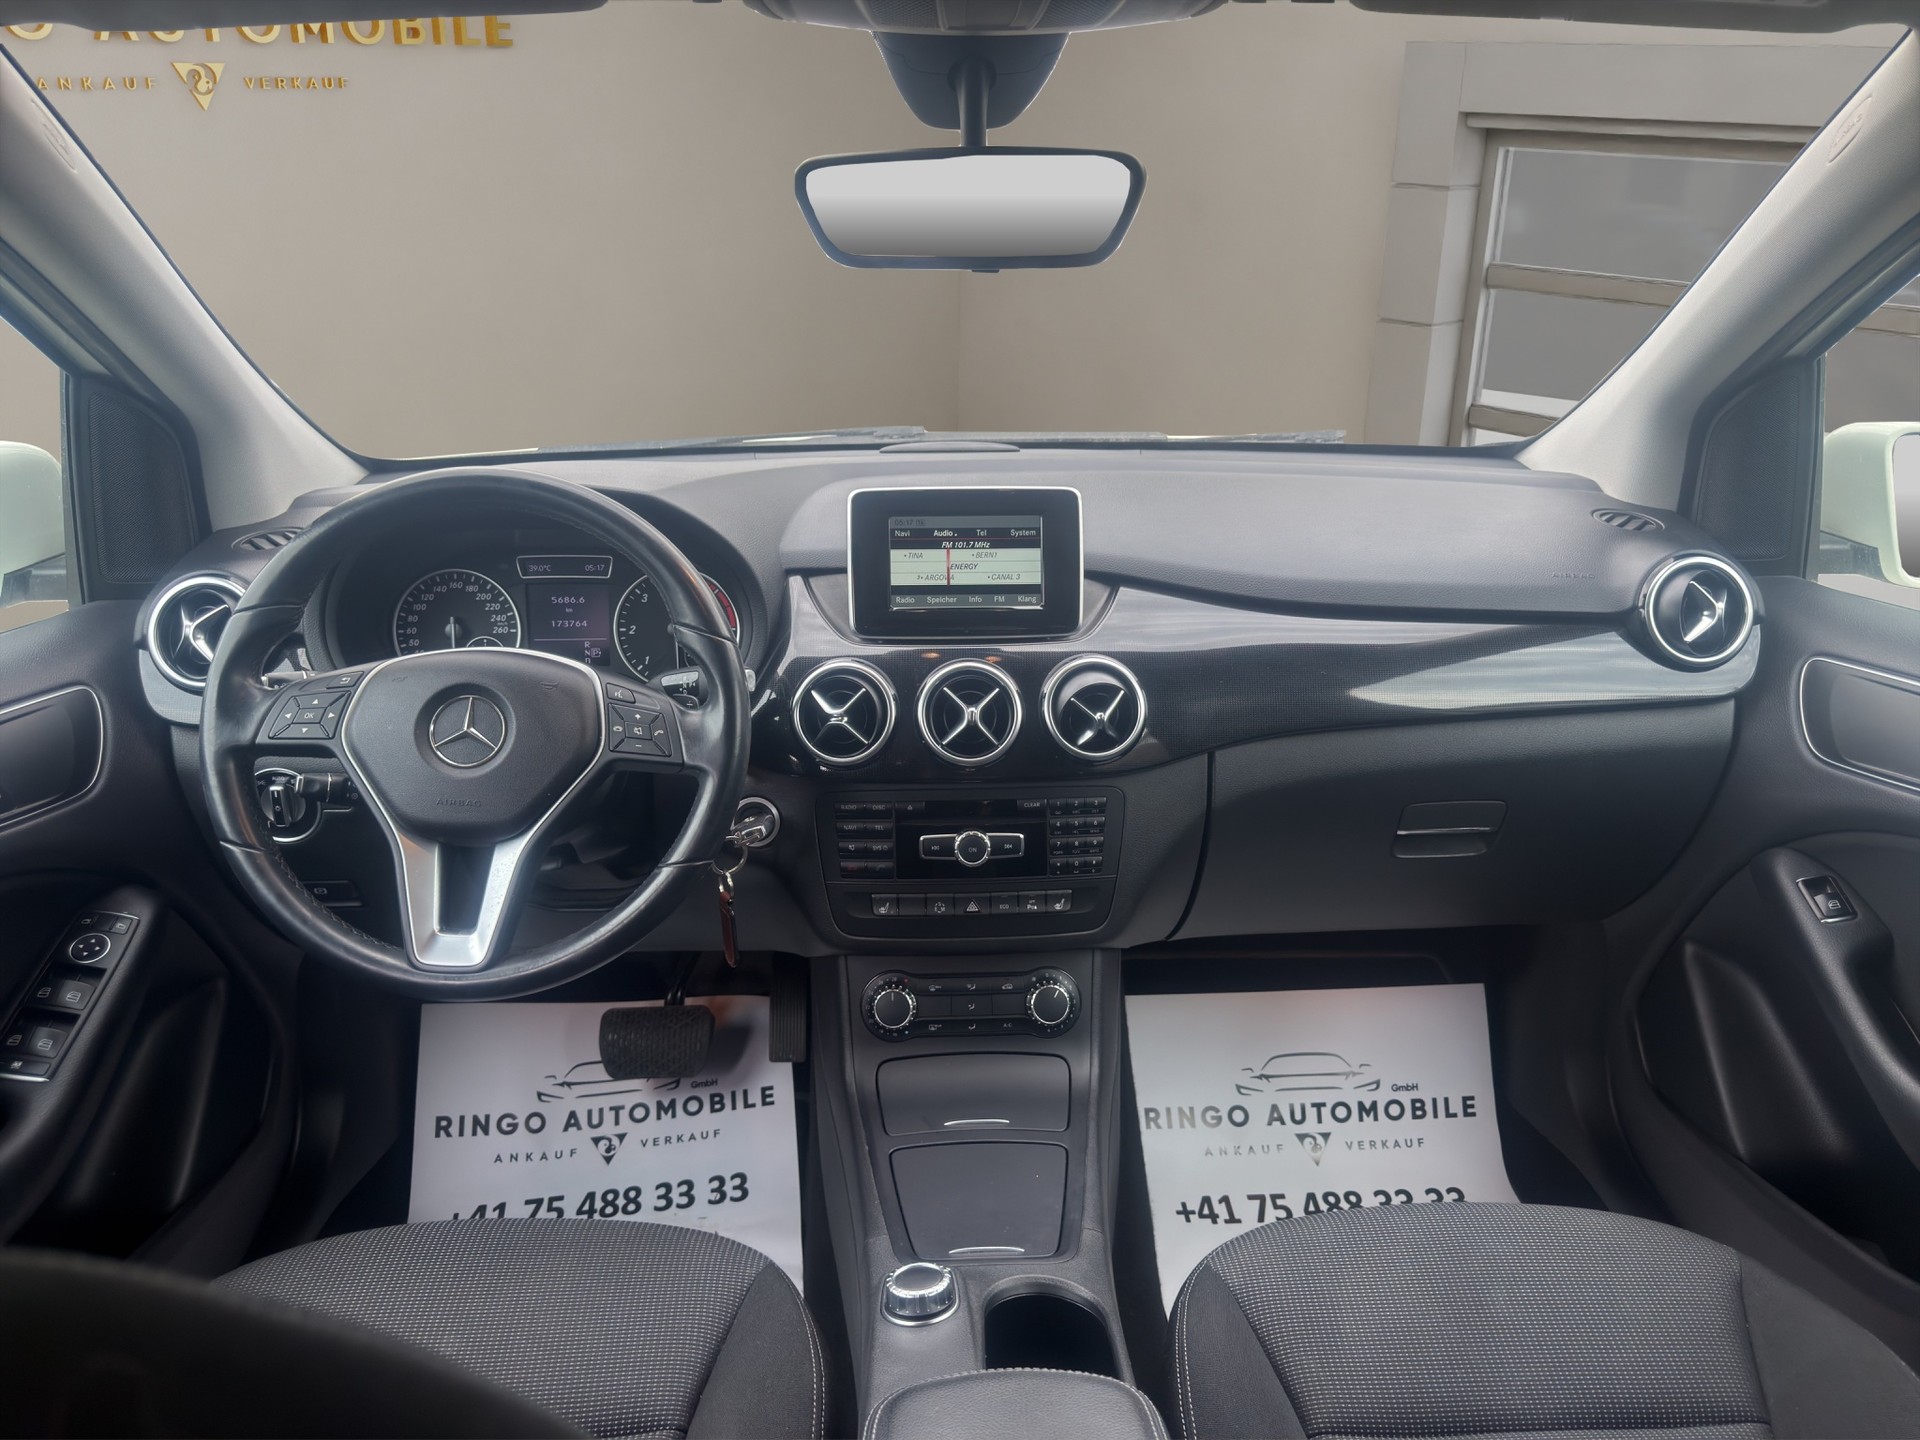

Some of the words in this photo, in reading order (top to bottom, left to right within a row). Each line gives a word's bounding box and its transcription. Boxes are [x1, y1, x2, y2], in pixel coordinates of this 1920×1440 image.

[36, 77, 157, 92] ANKAUF
[244, 76, 349, 90] VERKAUF
[933, 529, 954, 537] Audio
[1010, 529, 1036, 537] System
[941, 541, 953, 549] FM
[528, 564, 552, 572] 39.0°C
[584, 564, 606, 572] 05:17
[449, 581, 463, 589] 160
[421, 593, 435, 601] 120
[551, 596, 585, 604] 5686.6
[640, 593, 649, 603] 3
[927, 596, 957, 604] Speicher
[1017, 595, 1037, 604] Klang
[490, 614, 507, 622] 240
[492, 626, 509, 634] 260
[628, 626, 637, 634] 2
[408, 639, 420, 647] 50
[690, 1077, 719, 1089] GmbH
[1391, 1082, 1420, 1093] GmbH
[434, 1111, 547, 1139] RINGO
[562, 1085, 776, 1133] AUTOMOBILE
[1144, 1104, 1251, 1130] RINGO
[1266, 1095, 1478, 1128] AUTOMOBILE
[494, 1148, 579, 1164] ANKAUF
[640, 1128, 722, 1149] VERKAUF
[1204, 1143, 1285, 1158] ANKAUF
[1345, 1137, 1426, 1152] VERKAUF
[523, 1194, 566, 1220] 75
[575, 1186, 643, 1220] 488
[653, 1178, 696, 1213] 33
[707, 1172, 750, 1206] 33
[1175, 1195, 1242, 1225] +41
[1246, 1192, 1294, 1223] 75
